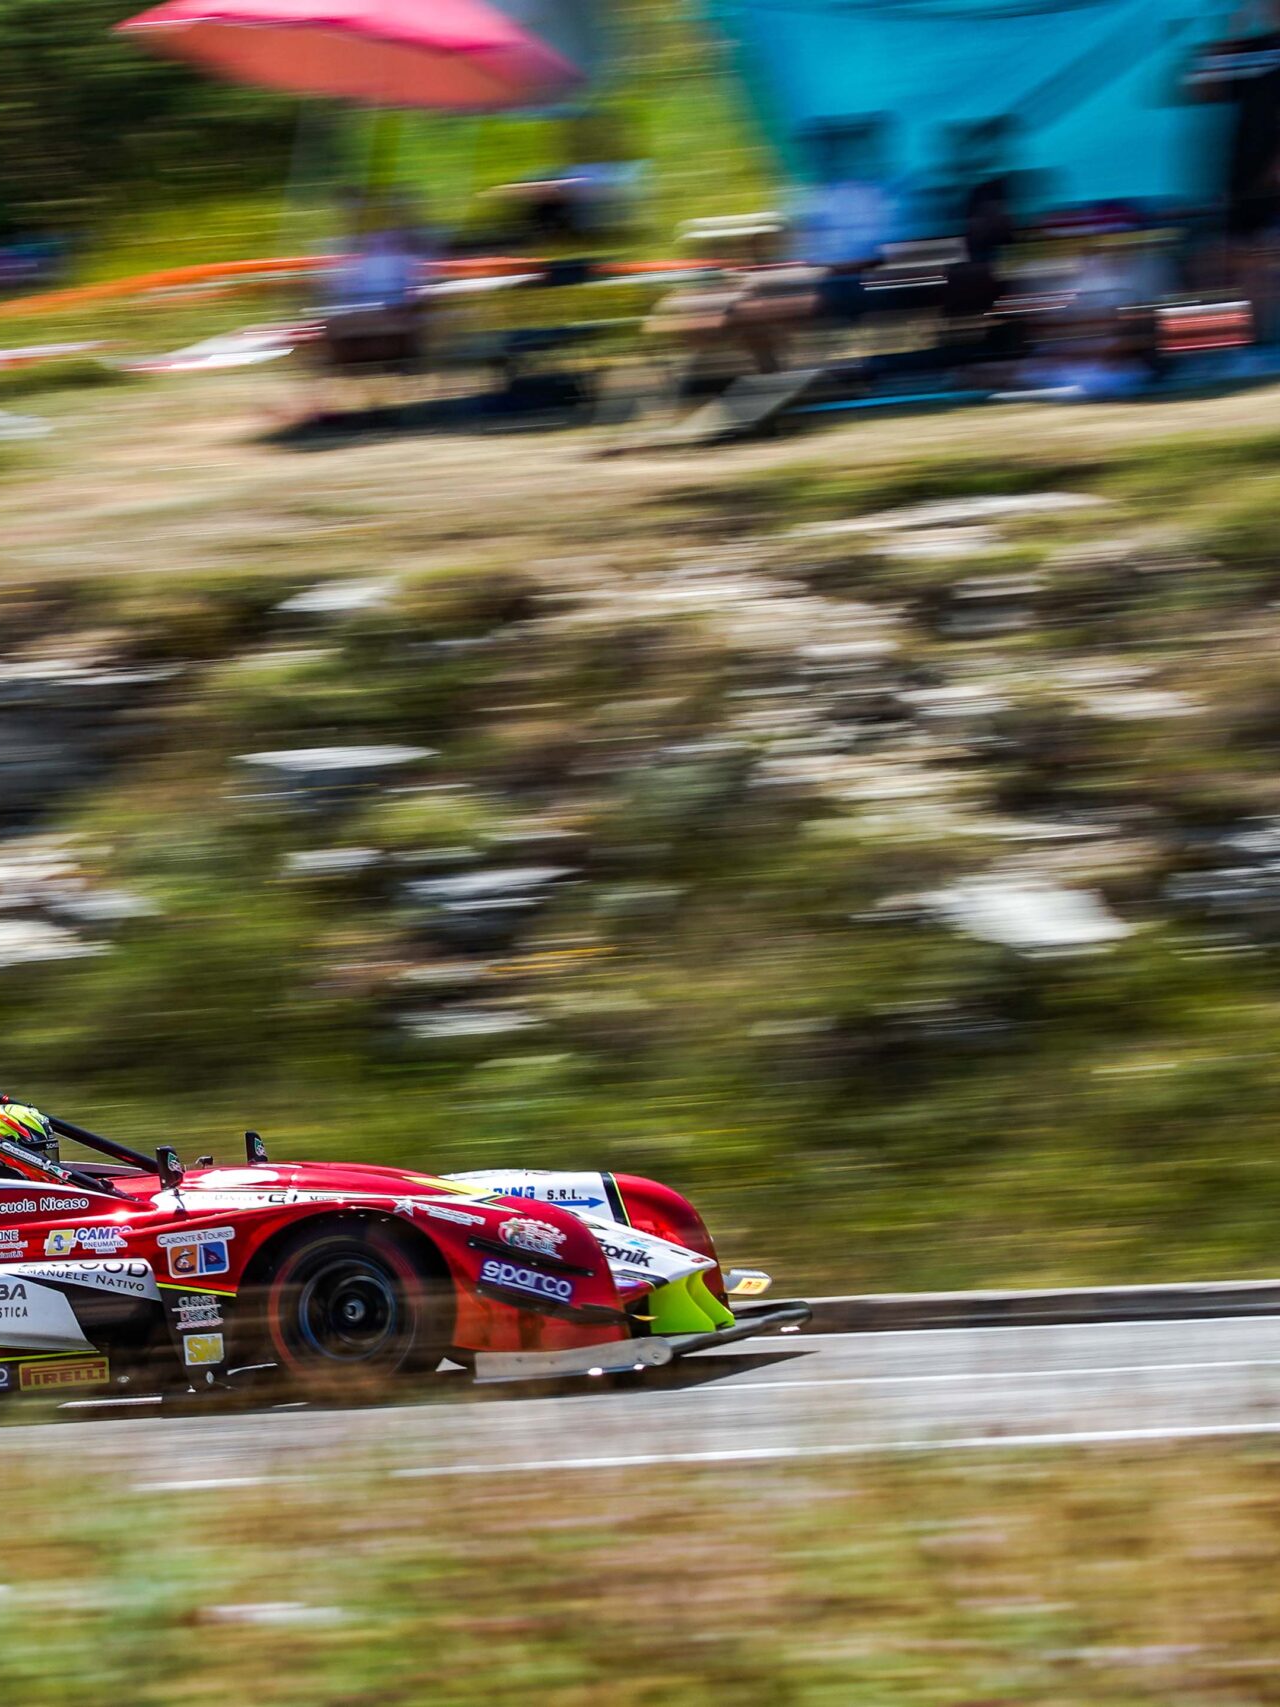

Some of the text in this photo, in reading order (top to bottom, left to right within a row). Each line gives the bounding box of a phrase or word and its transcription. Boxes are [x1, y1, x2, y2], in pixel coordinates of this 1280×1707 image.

[547, 1189, 582, 1200] S.R.L.
[40, 1198, 89, 1210] Nicaso
[96, 1275, 144, 1291] NATIVO
[482, 1260, 572, 1297] sparco
[22, 1361, 106, 1386] PIRELLI
